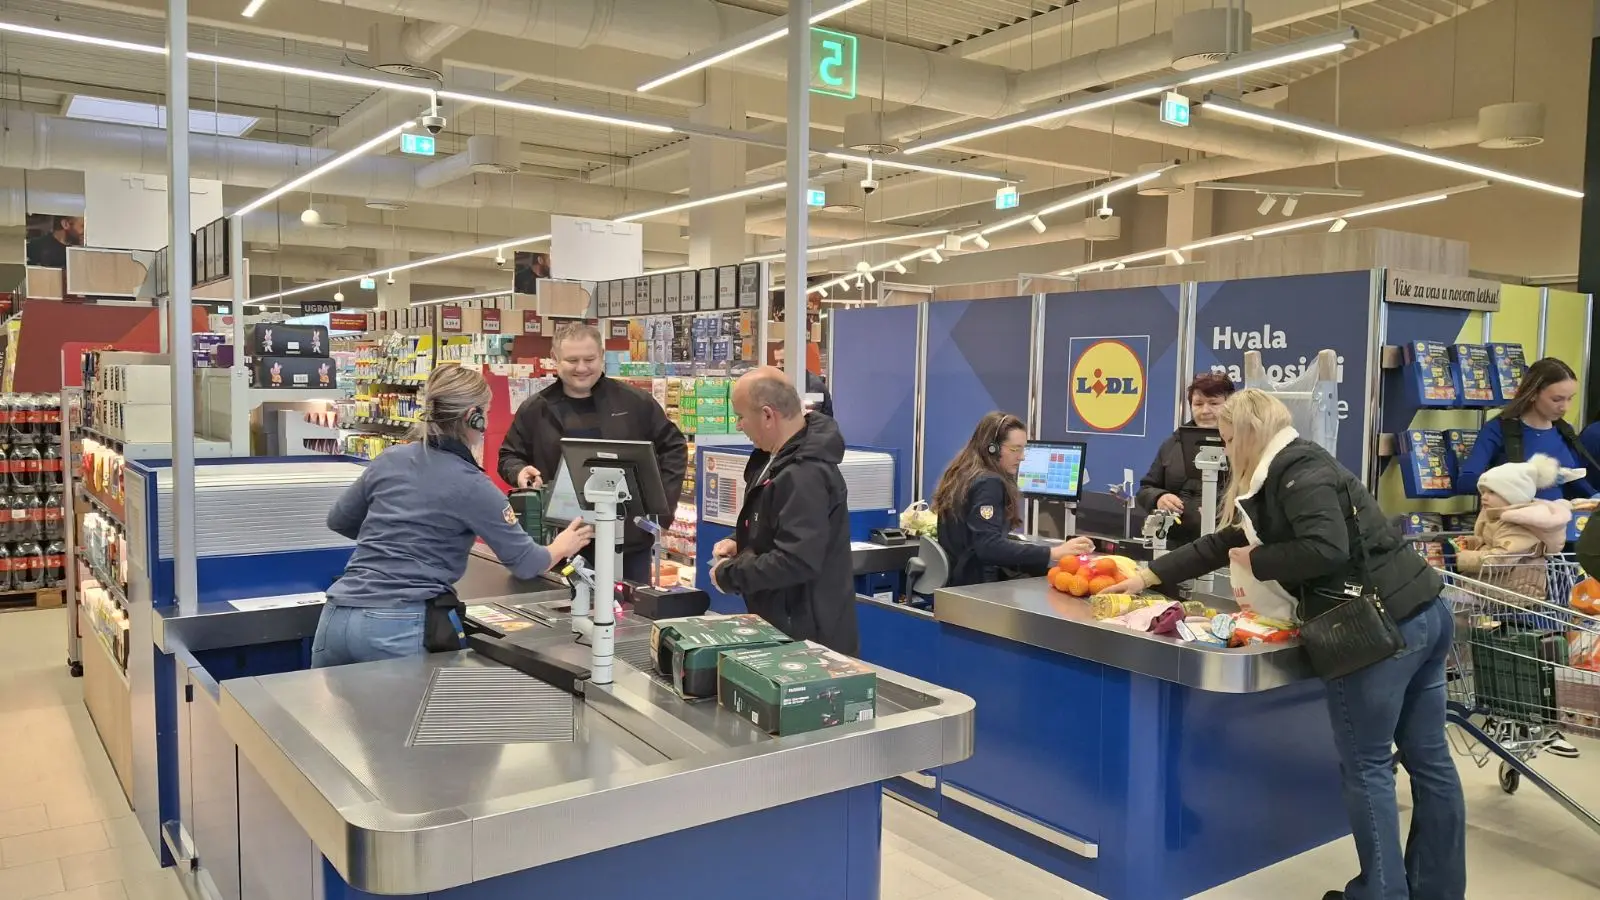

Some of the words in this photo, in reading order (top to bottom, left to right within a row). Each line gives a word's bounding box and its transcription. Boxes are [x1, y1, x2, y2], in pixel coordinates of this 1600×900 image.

[1413, 285, 1424, 298] za
[1425, 286, 1440, 299] vas
[1441, 288, 1447, 300] u
[1448, 288, 1475, 303] novom
[1212, 324, 1288, 350] Hvala
